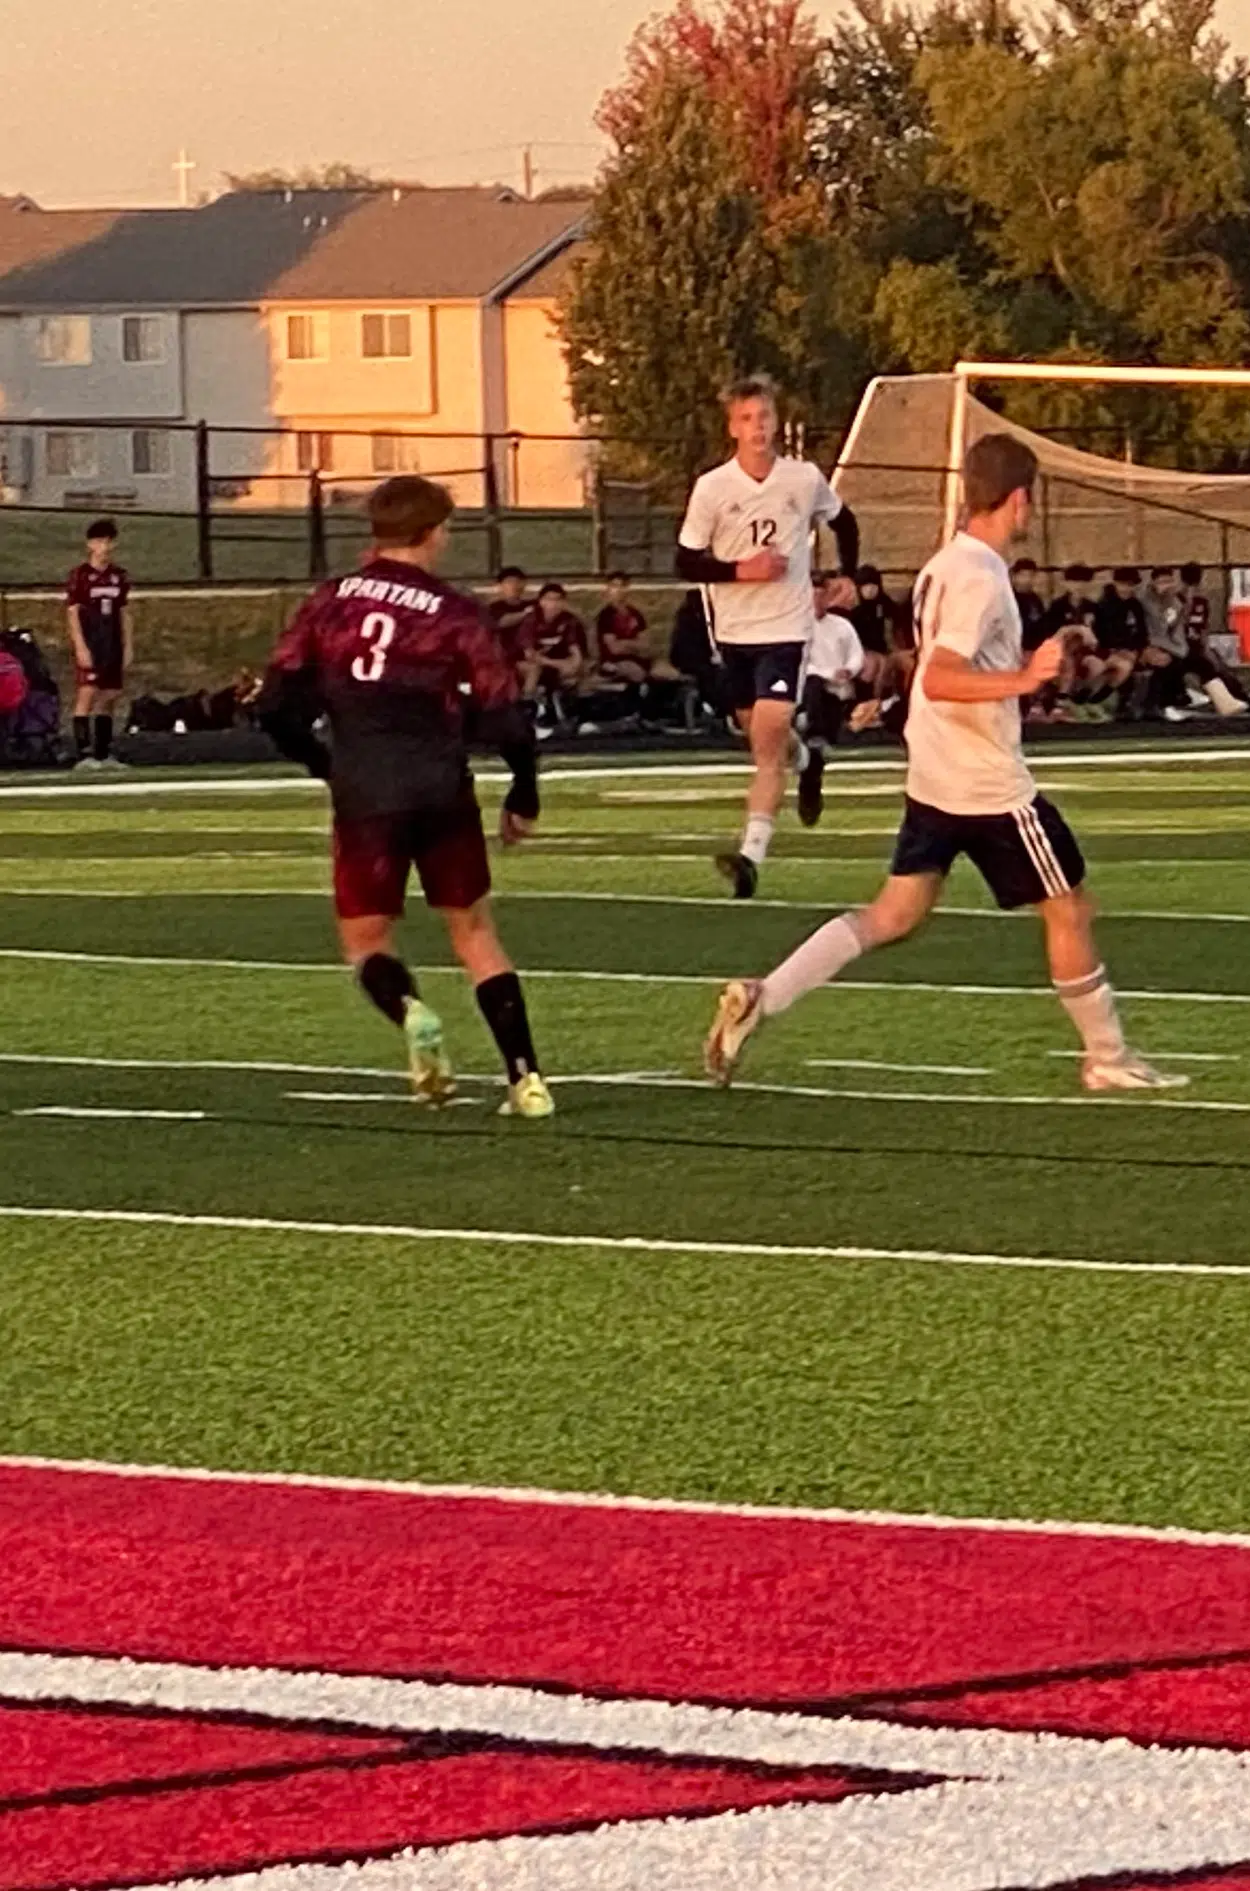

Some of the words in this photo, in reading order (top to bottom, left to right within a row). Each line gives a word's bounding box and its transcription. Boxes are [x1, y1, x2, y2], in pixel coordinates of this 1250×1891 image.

[750, 518, 777, 547] 12
[336, 577, 444, 614] SPARTANS
[351, 611, 395, 681] 3
